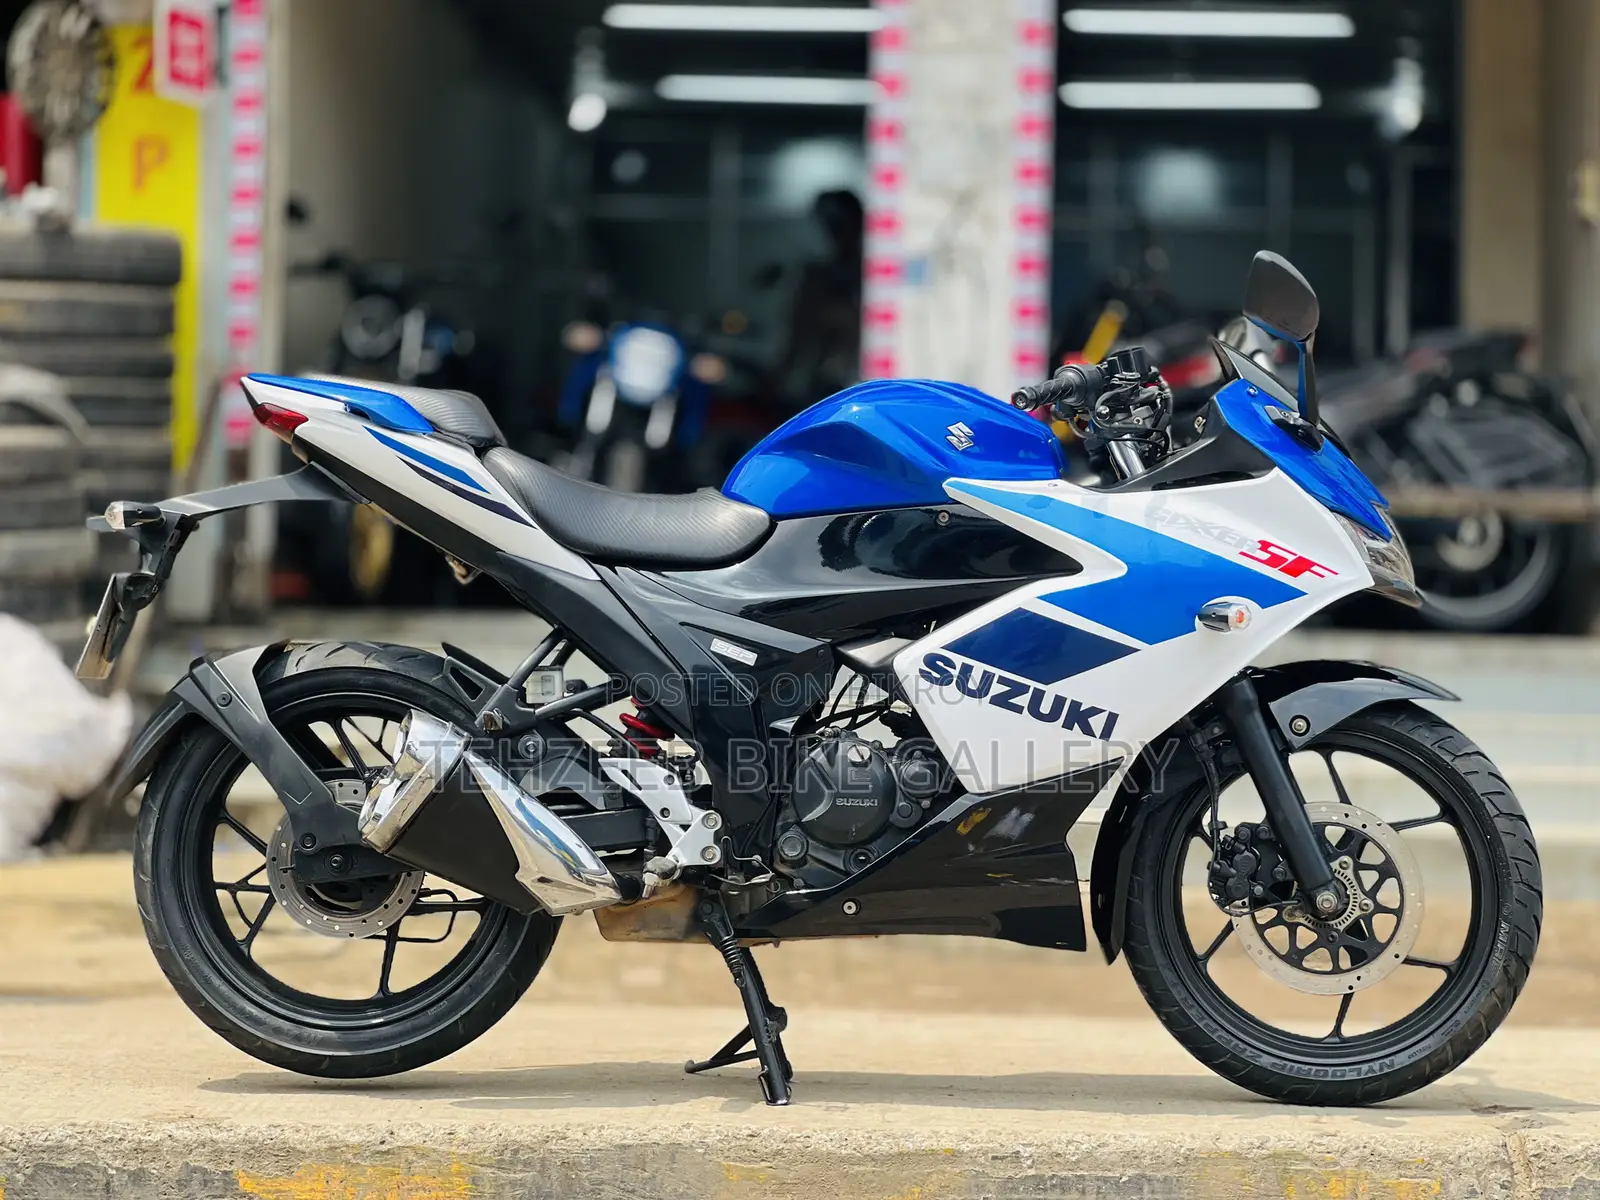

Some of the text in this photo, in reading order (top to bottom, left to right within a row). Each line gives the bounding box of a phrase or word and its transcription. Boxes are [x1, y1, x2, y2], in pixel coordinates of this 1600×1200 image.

[1238, 539, 1340, 579] SF
[918, 652, 1120, 742] SUZUKI
[835, 797, 879, 807] SUZUKI
[1270, 1058, 1396, 1080] NYLOGRIP
